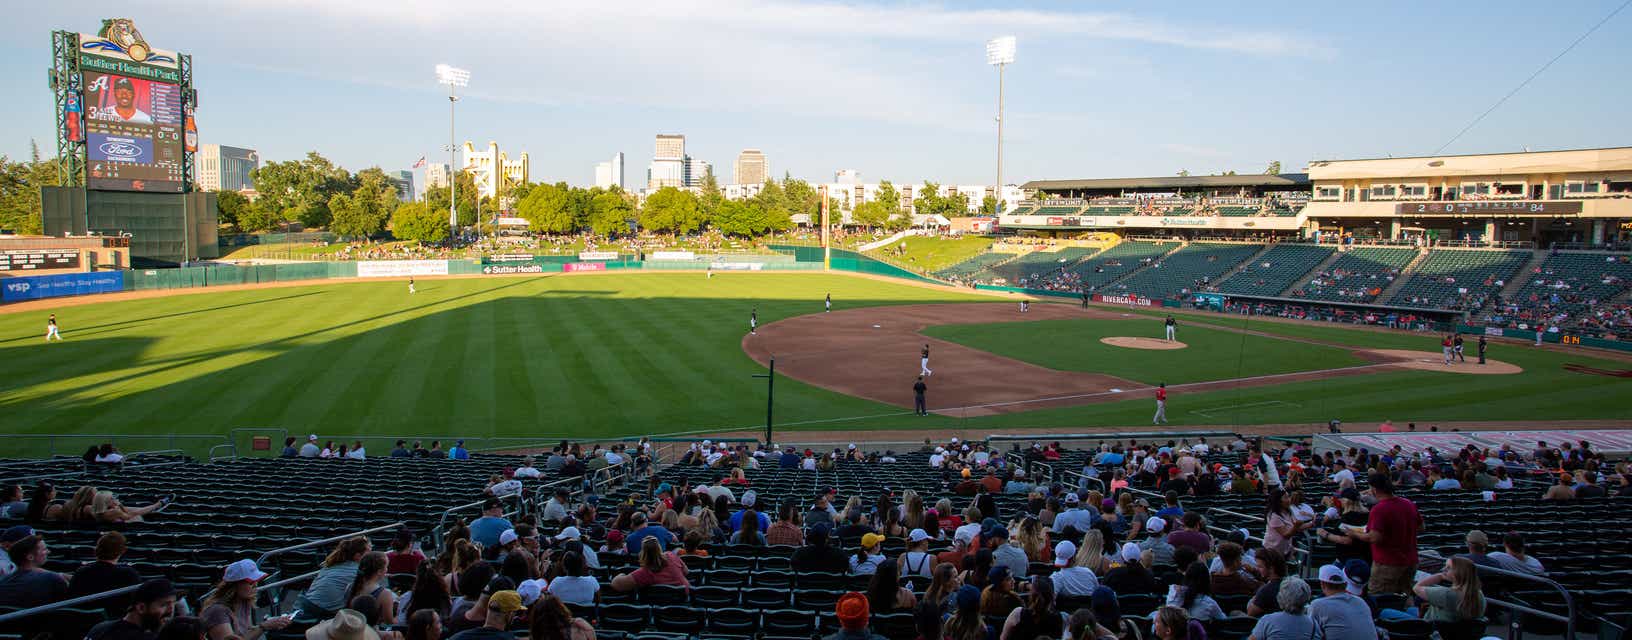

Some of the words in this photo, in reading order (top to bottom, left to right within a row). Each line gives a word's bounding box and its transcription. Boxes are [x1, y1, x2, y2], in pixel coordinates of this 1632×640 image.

[81, 55, 118, 71] Sutter
[119, 62, 154, 77] Health
[155, 68, 179, 81] Park
[88, 76, 109, 91] A
[88, 106, 97, 119] 3
[108, 143, 135, 155] Ford
[1418, 204, 1425, 212] 2
[1446, 203, 1453, 212] 0
[1530, 203, 1544, 212] 84
[492, 265, 517, 273] Sutter
[518, 264, 543, 273] Health
[7, 282, 31, 293] vsp
[1102, 295, 1151, 306] RIVERCA.COM
